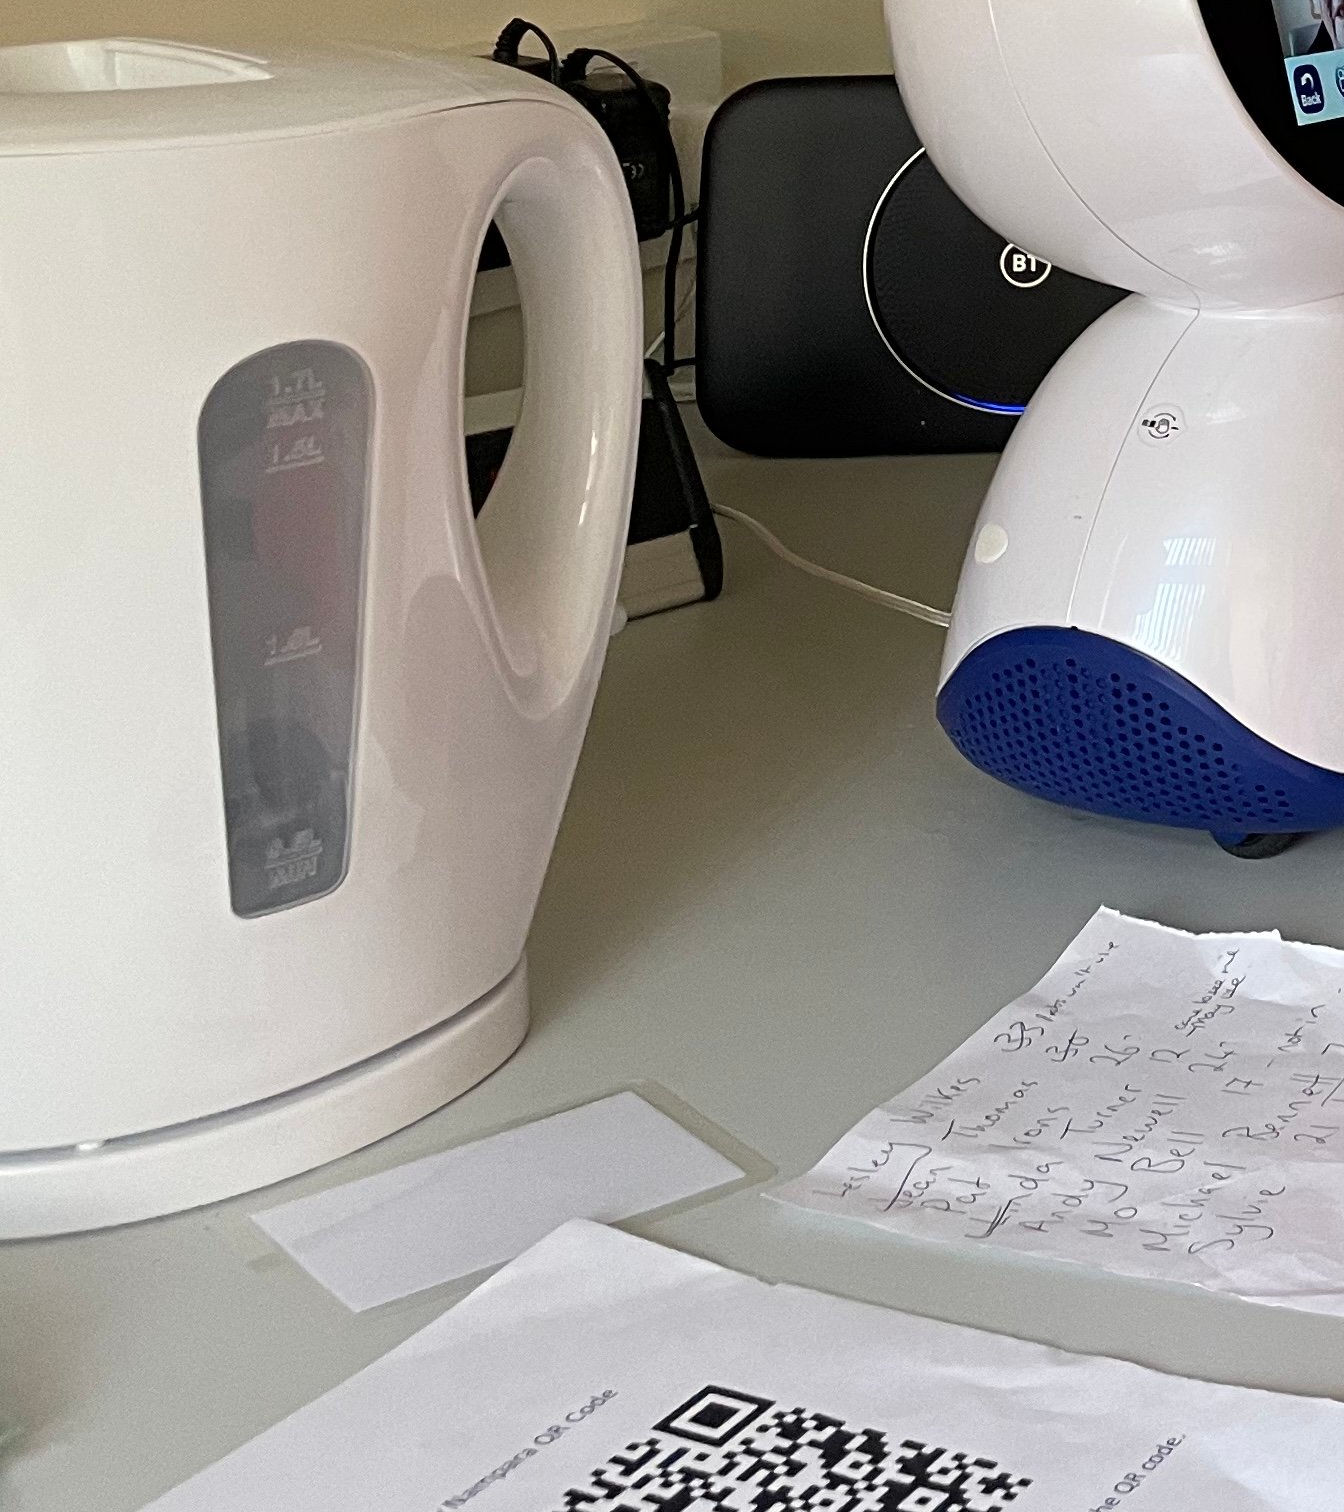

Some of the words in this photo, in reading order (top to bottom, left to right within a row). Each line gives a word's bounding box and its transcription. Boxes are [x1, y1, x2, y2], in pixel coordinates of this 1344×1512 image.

[1302, 92, 1322, 106] Back
[1012, 254, 1037, 272] BT
[812, 1142, 932, 1198] Lesley
[890, 1078, 981, 1124] Wilkes
[941, 1080, 1038, 1140] Thomas
[1060, 1084, 1142, 1140] Turner
[1019, 1179, 1128, 1233] Andy
[1092, 1093, 1188, 1162] Newell
[1080, 1206, 1138, 1237] Mo
[1131, 1131, 1204, 1173] Bell
[1221, 1077, 1264, 1095] 17
[1139, 1161, 1246, 1251] Michael
[1222, 1073, 1341, 1141] Bennett
[921, 1176, 990, 1214] Pat
[1188, 1186, 1286, 1254] Sylvie
[534, 1425, 571, 1445] QR
[566, 1390, 618, 1422] Code
[1114, 1472, 1146, 1494] QR
[1142, 1433, 1186, 1470] code.
